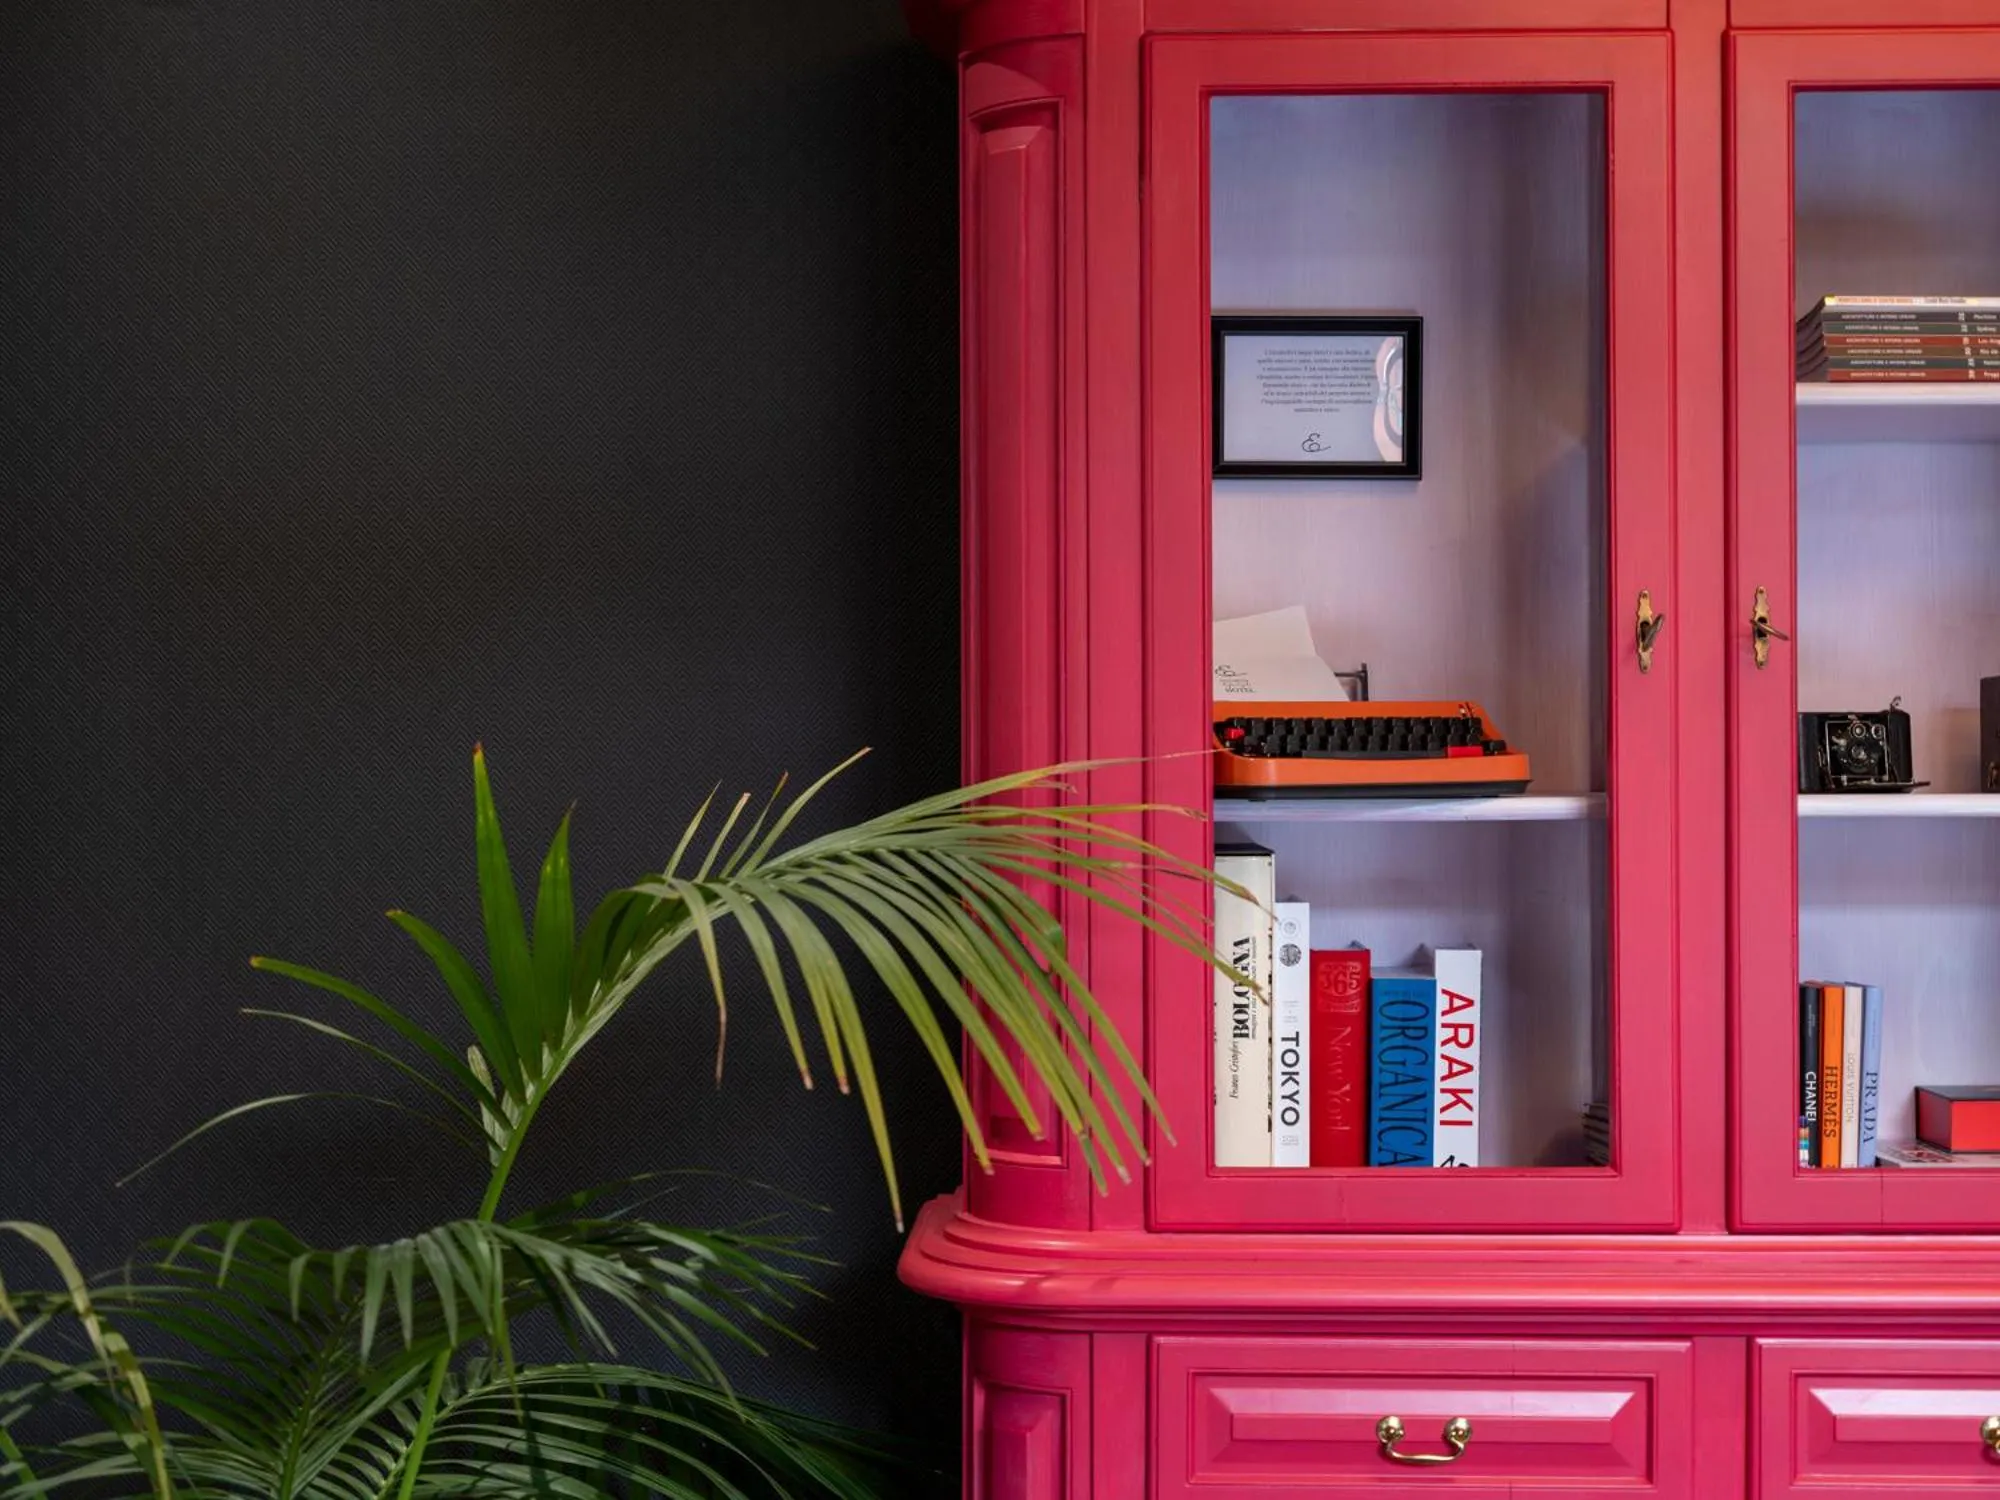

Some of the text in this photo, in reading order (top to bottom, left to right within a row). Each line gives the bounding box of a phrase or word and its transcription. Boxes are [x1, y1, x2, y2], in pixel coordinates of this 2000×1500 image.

[1320, 971, 1360, 995] 365
[1280, 1031, 1300, 1127] TOKYO
[1327, 1026, 1352, 1080] New
[1377, 1000, 1430, 1167] ORGANICA
[1439, 988, 1474, 1127] ARAKI
[1863, 1071, 1878, 1143] PRADA
